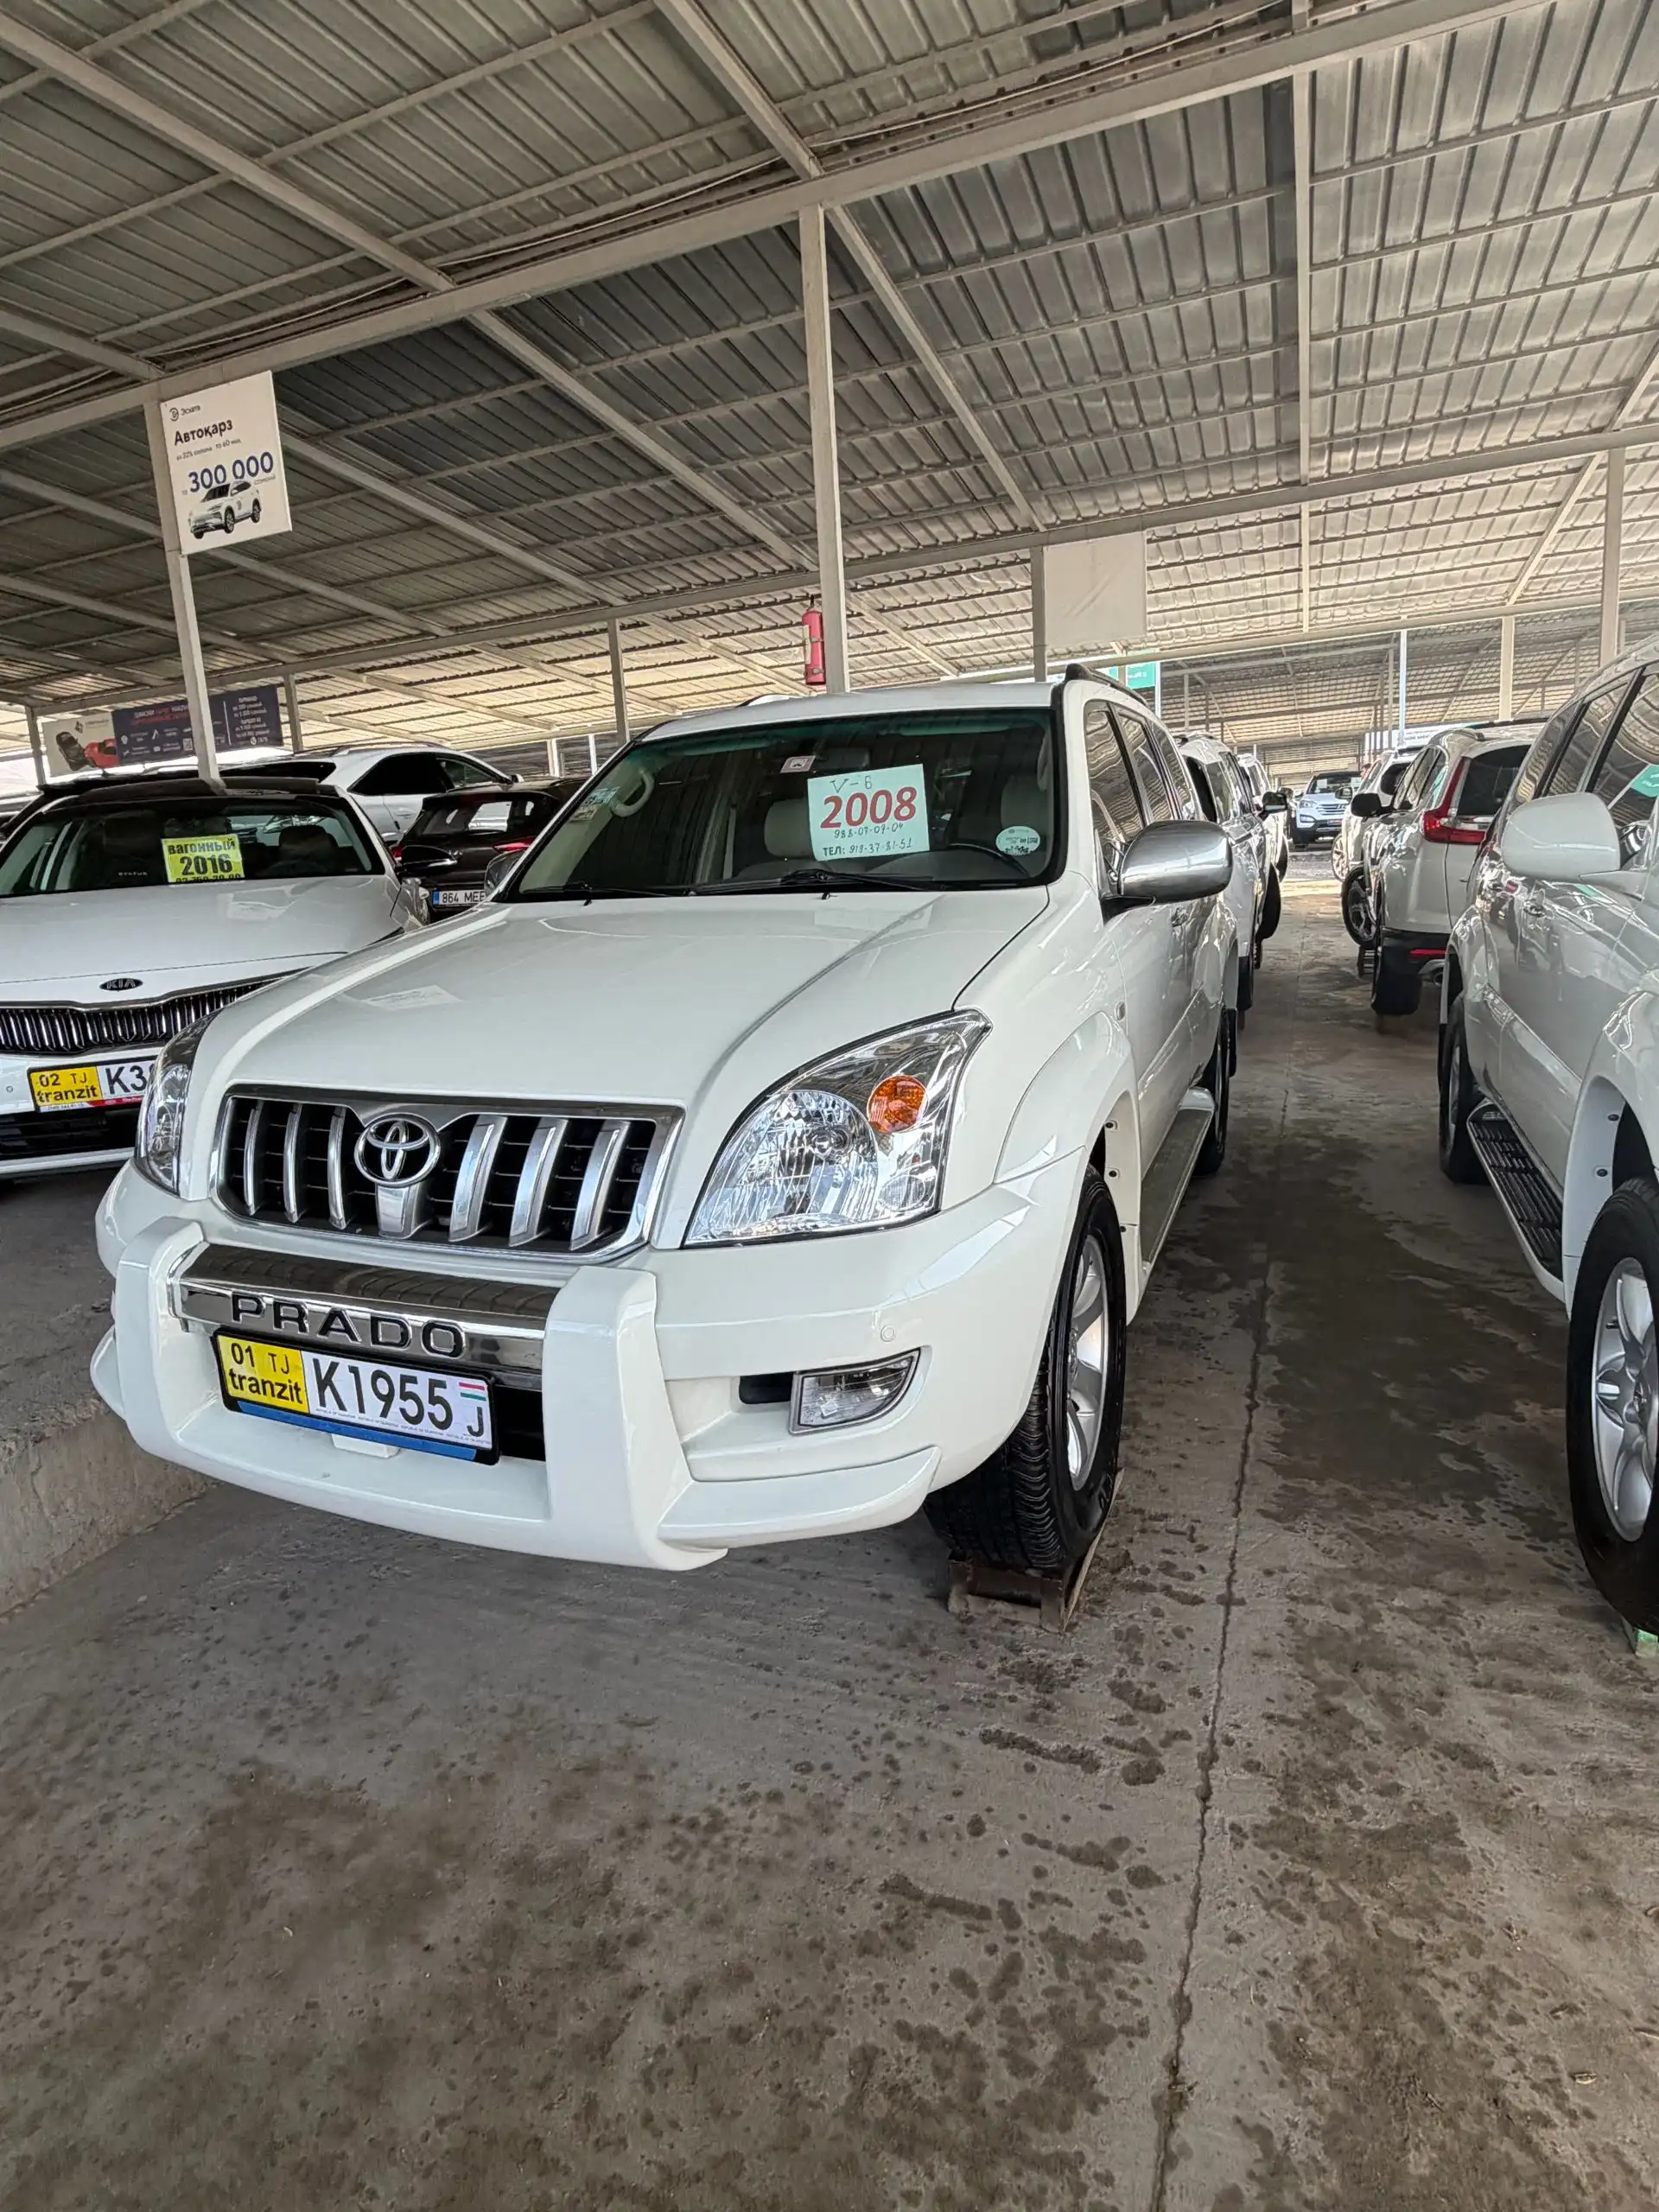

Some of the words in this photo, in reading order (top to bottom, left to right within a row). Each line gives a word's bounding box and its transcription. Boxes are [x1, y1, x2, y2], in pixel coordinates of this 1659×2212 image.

[181, 405, 200, 416] Эсхата
[174, 419, 233, 446] Автоқарз
[188, 464, 227, 493] 300
[232, 451, 274, 480] 000
[820, 786, 918, 829] 2008
[823, 846, 845, 856] ТЕЛ:
[180, 854, 233, 876] 2016
[442, 893, 459, 903] 864
[106, 979, 136, 989] KIA
[39, 1073, 60, 1087] 02
[72, 1071, 87, 1084] TJ
[105, 1064, 155, 1095] K3
[36, 1084, 99, 1103] tranzit
[232, 1292, 467, 1358] PRADO
[231, 1342, 255, 1368] 01
[268, 1352, 289, 1375] TJ
[228, 1368, 303, 1404] tranzit
[312, 1357, 454, 1430] K1955
[467, 1407, 485, 1438] J
